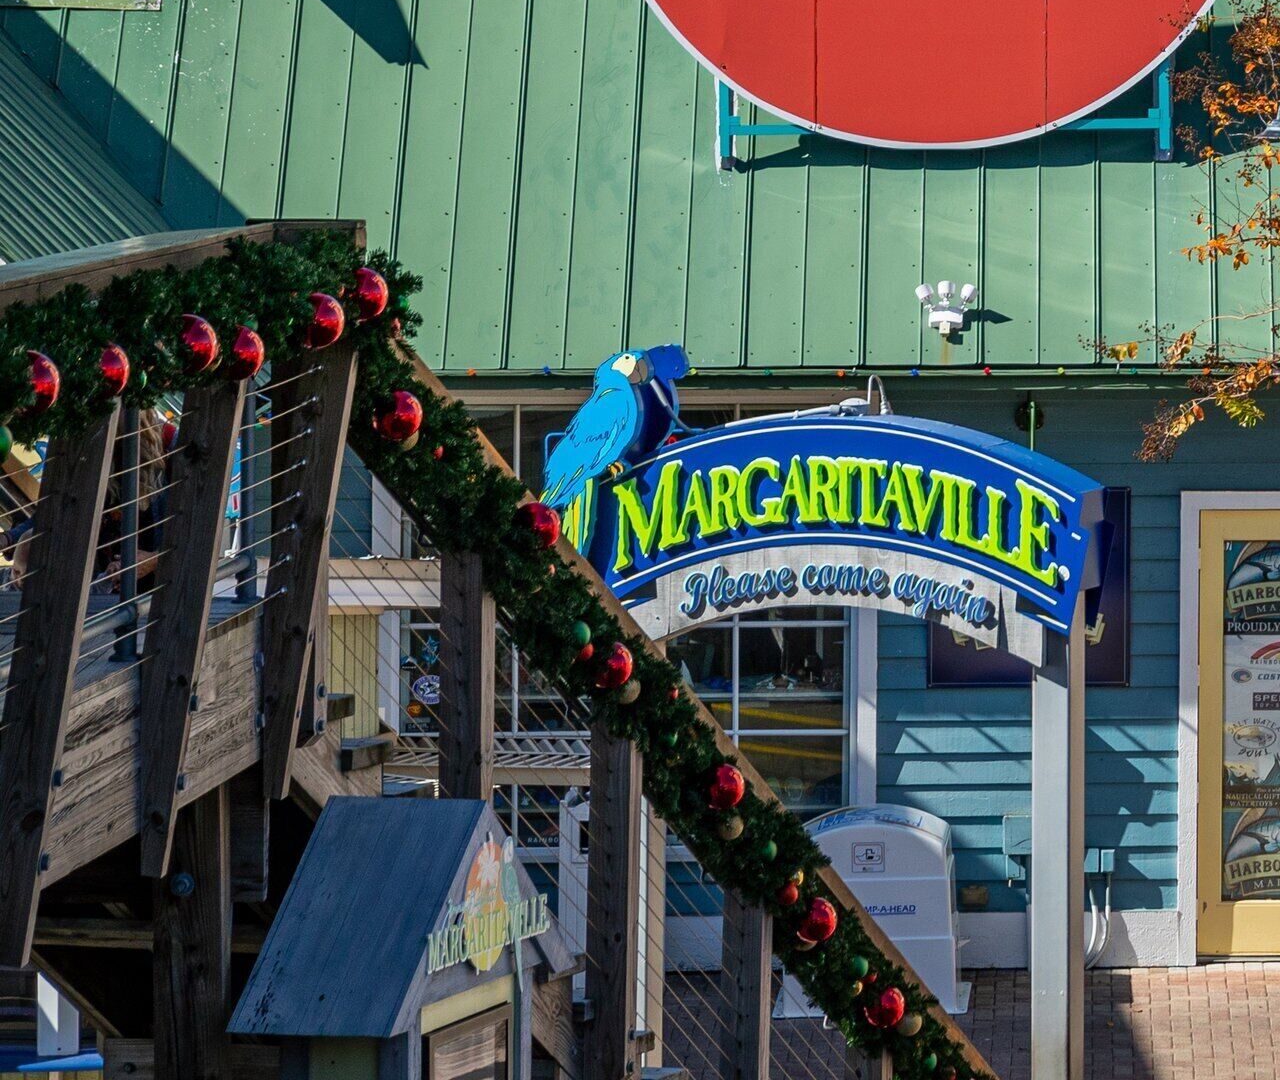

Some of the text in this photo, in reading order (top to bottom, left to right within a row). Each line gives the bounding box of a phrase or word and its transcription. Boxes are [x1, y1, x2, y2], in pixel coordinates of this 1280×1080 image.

[612, 454, 1062, 588] MARGARITAVILLE
[679, 561, 995, 624] Please come again
[1227, 621, 1280, 632] PROUDLY
